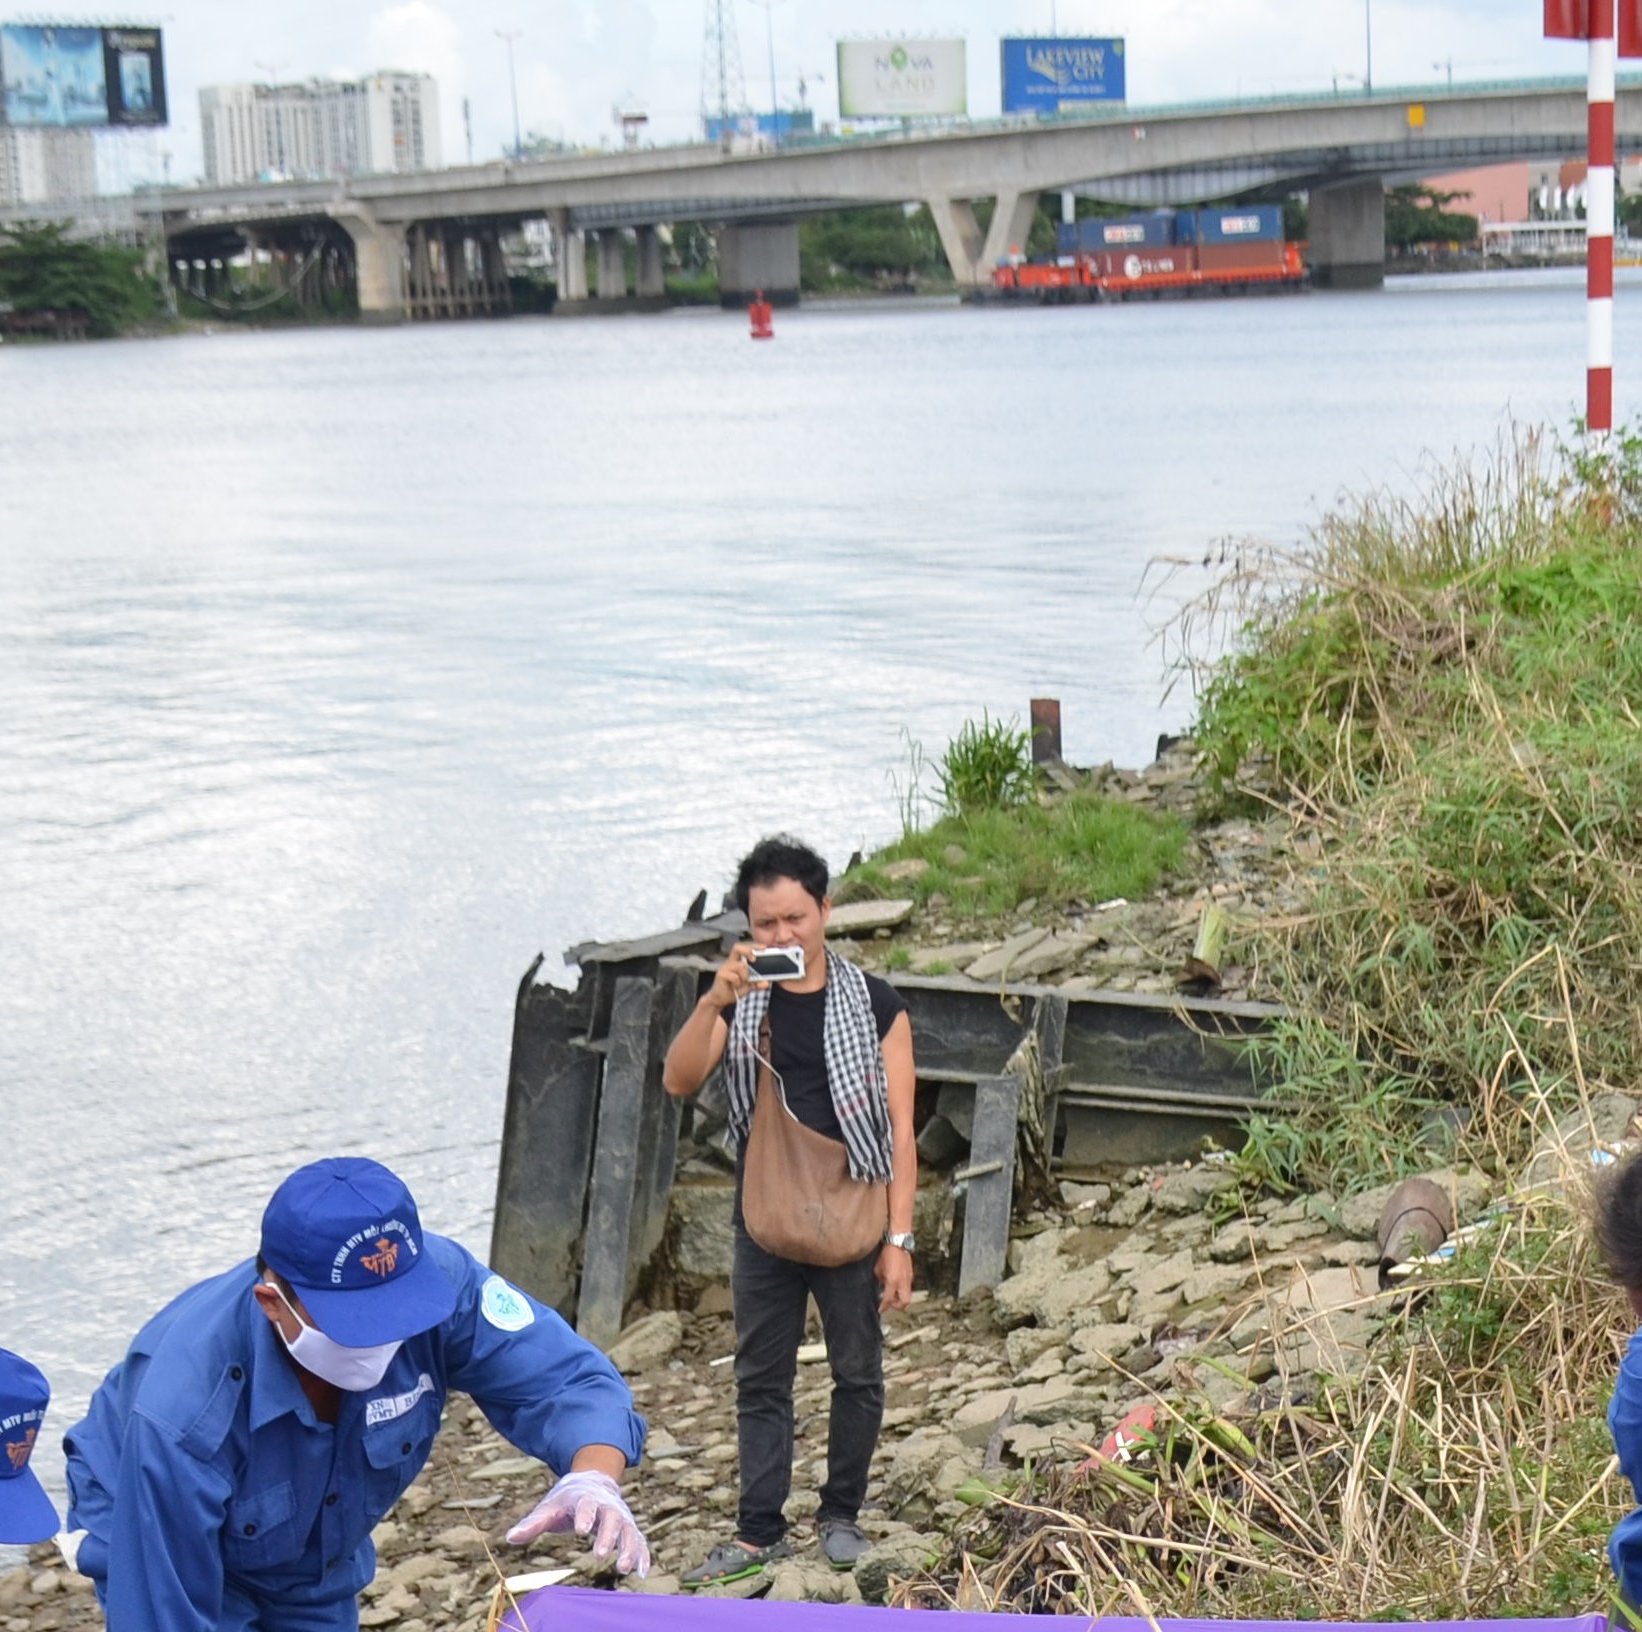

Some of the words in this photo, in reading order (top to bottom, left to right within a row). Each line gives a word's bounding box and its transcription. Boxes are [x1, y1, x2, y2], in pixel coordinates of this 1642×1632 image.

[1026, 44, 1105, 66] LAKEVIEW
[1072, 63, 1105, 81] CITY
[874, 76, 935, 92] LAND
